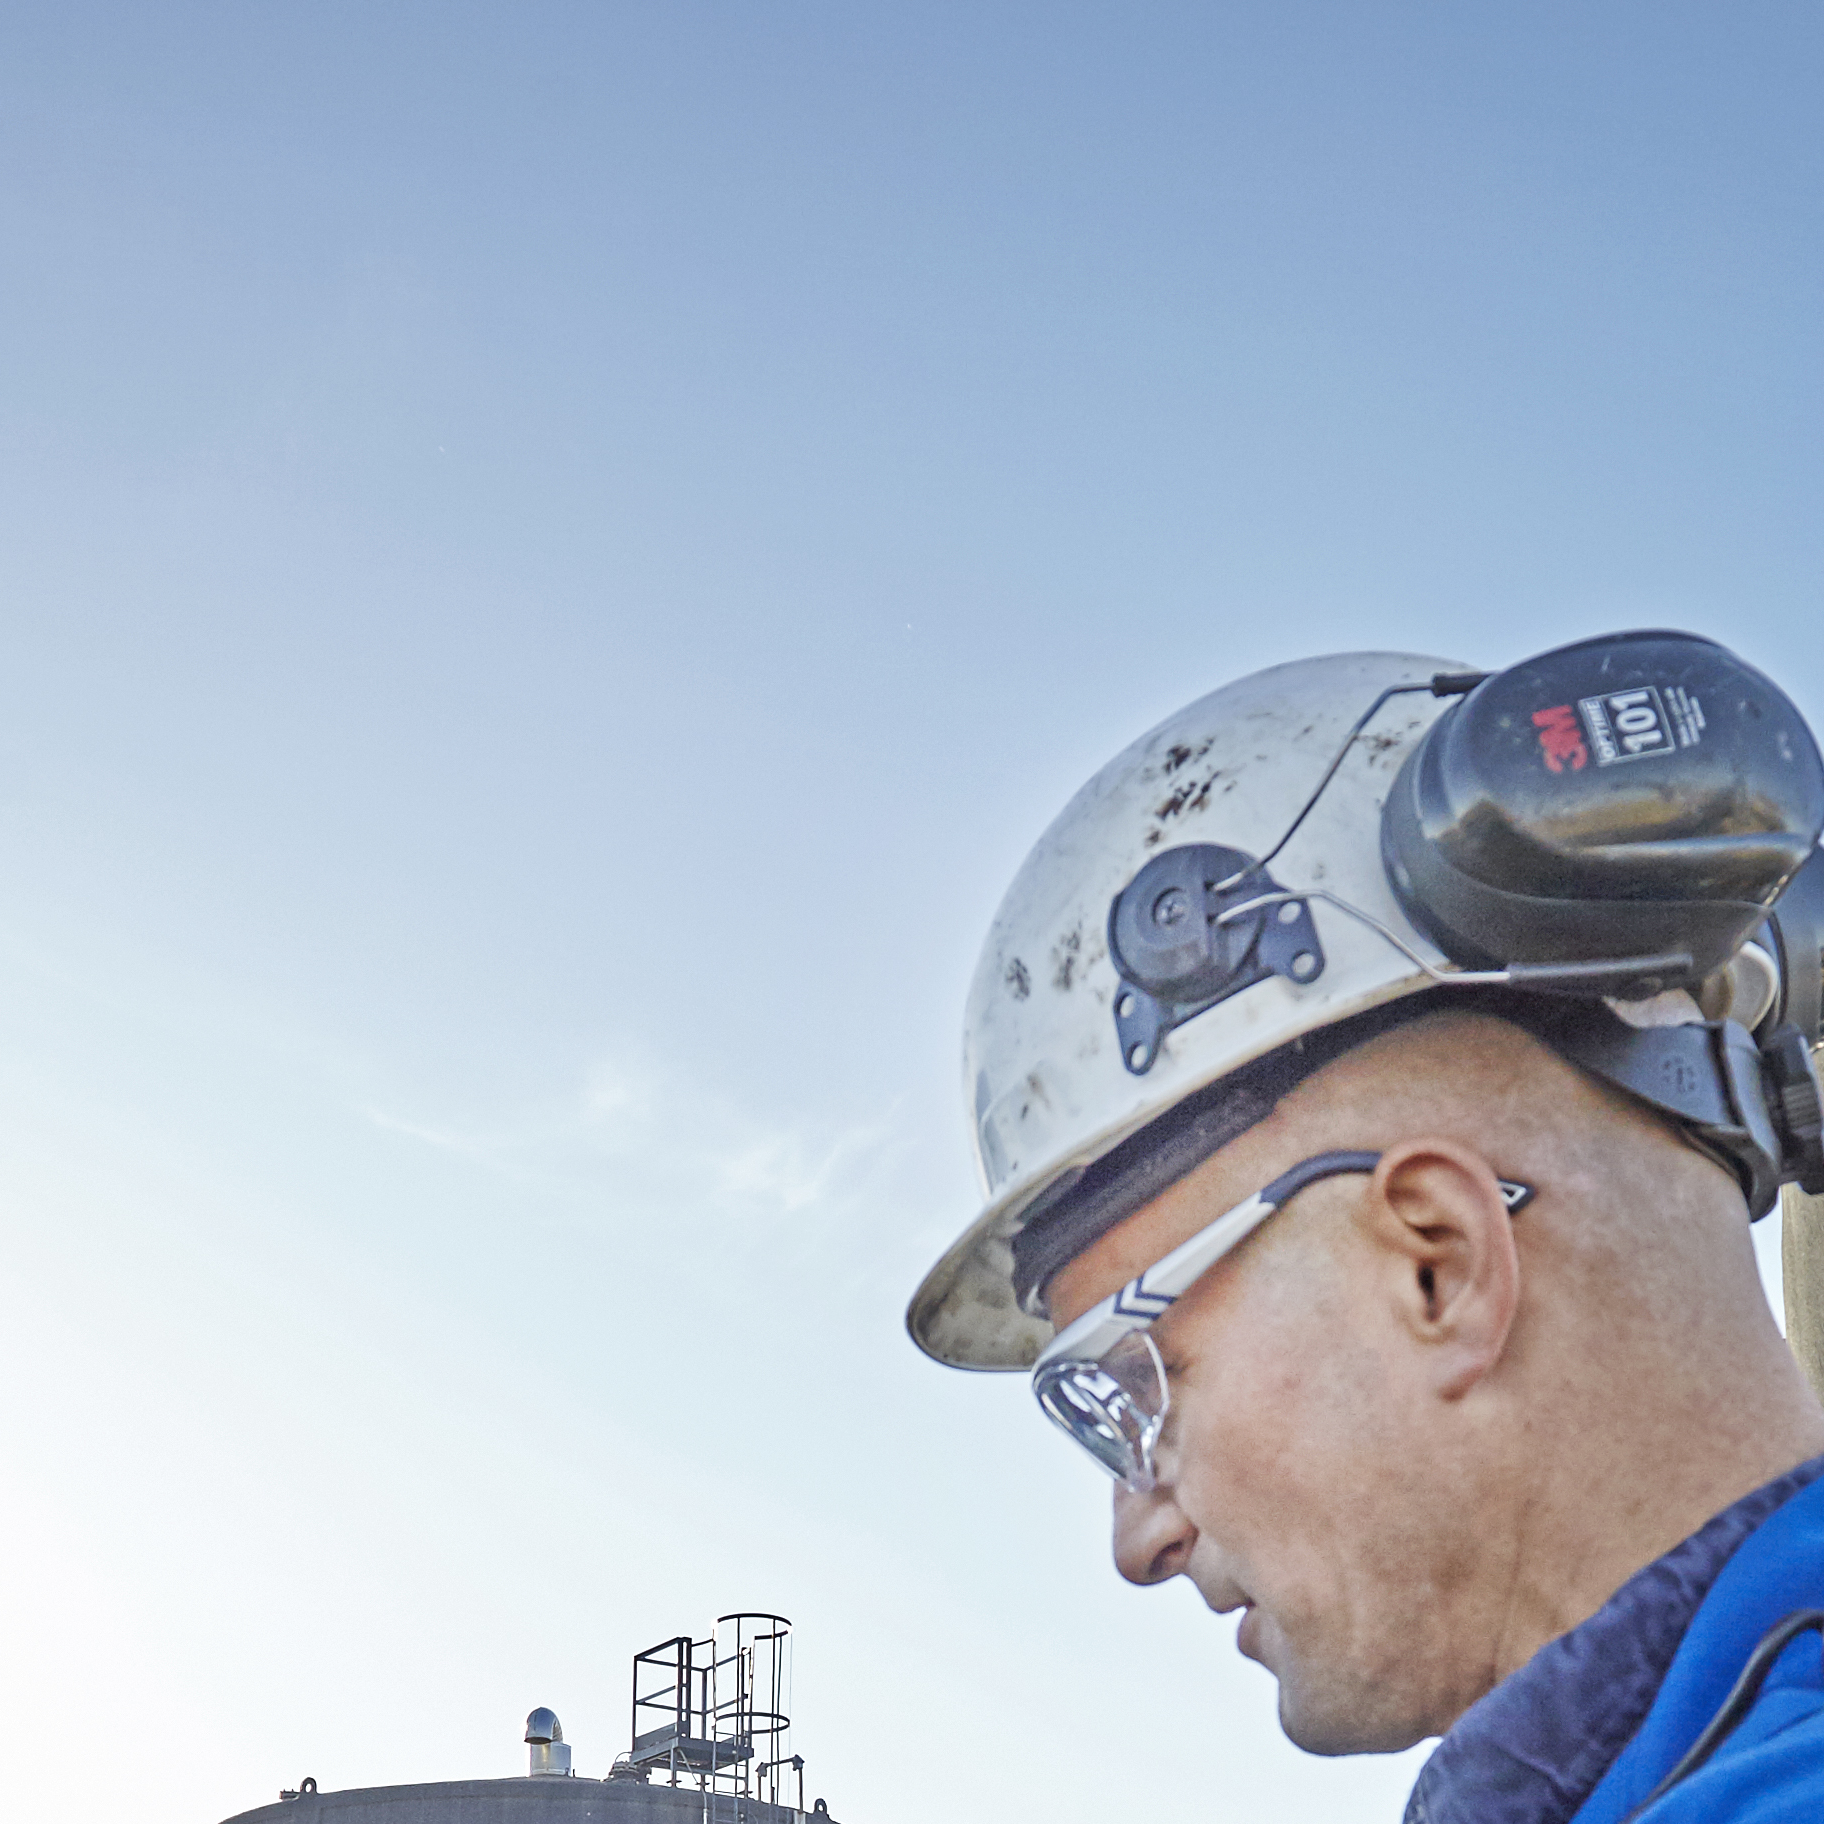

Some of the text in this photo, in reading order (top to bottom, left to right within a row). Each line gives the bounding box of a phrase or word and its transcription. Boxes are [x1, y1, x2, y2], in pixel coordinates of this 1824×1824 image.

[1533, 705, 1586, 773] 3M
[1585, 700, 1617, 764] OPTIME
[1611, 689, 1663, 755] 101
